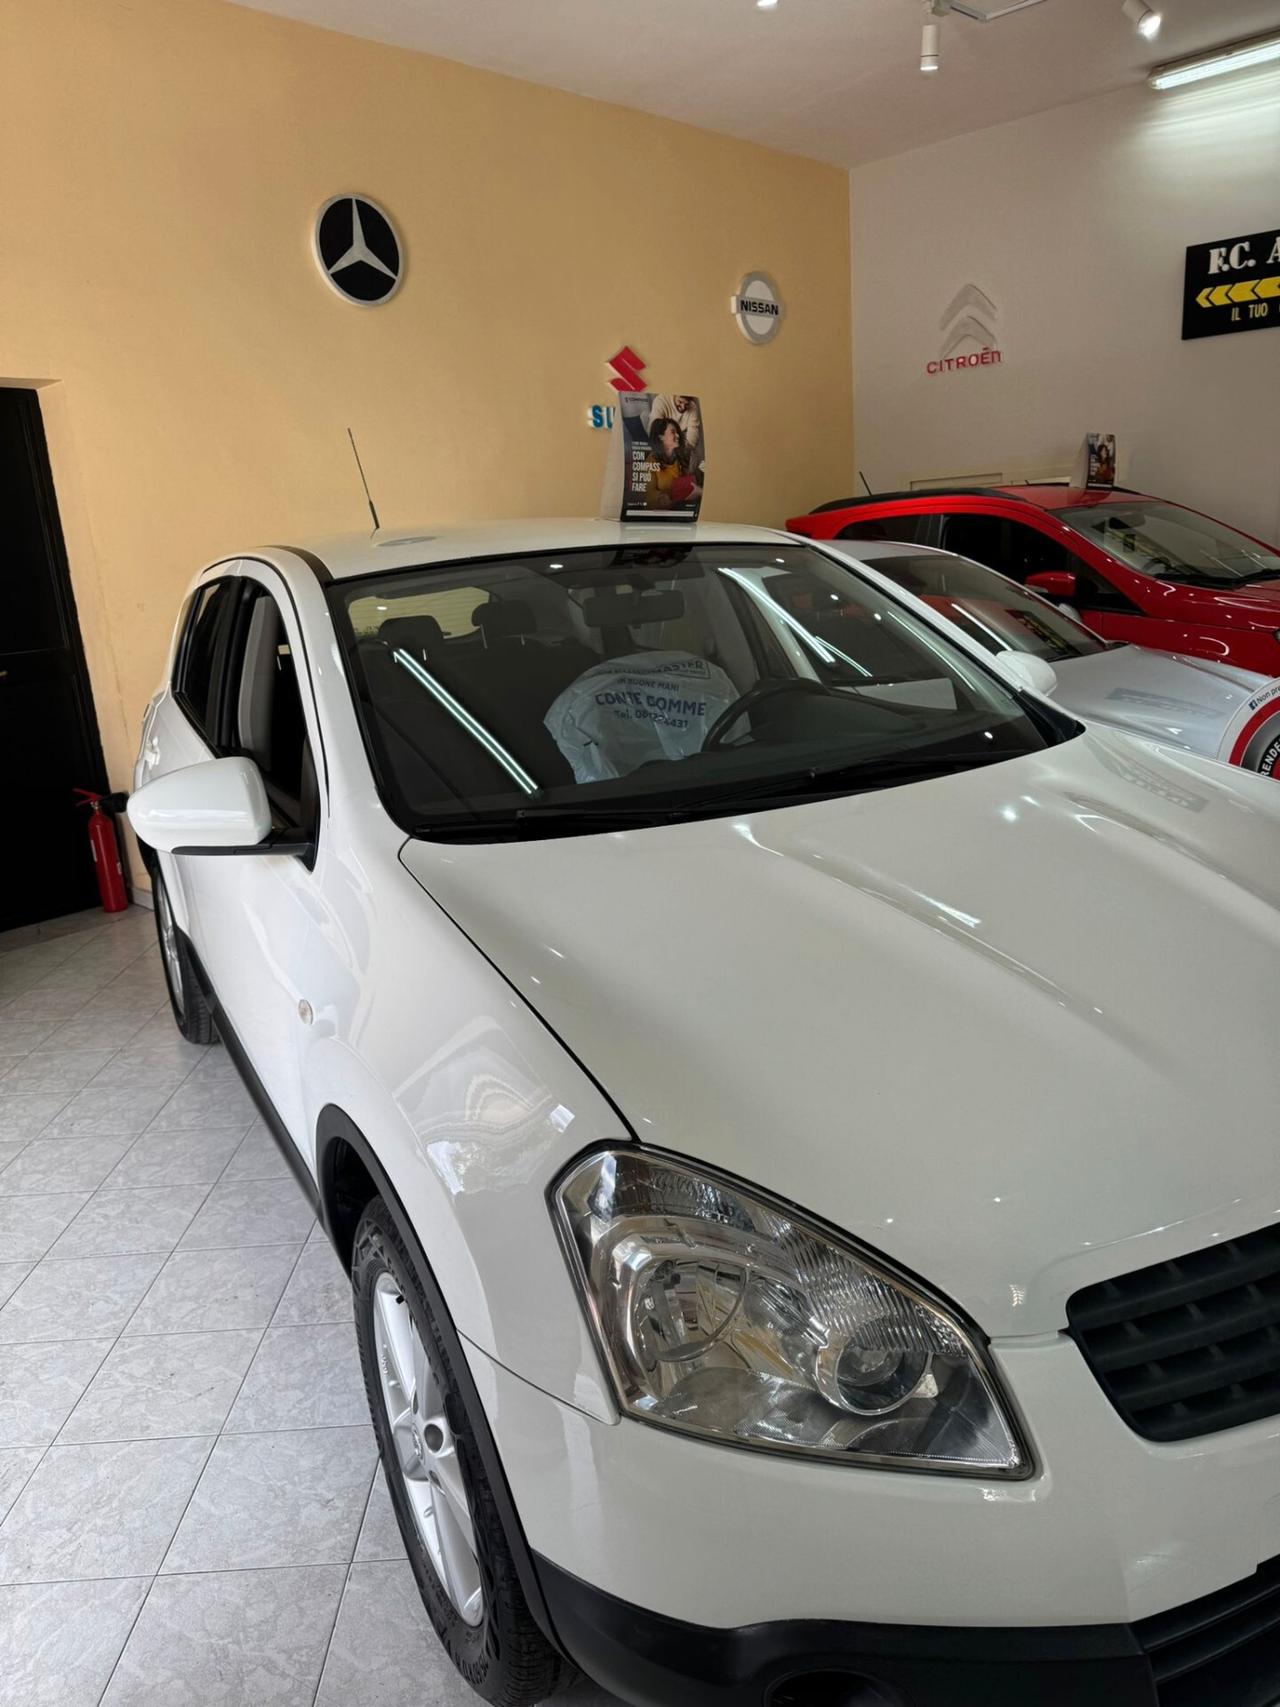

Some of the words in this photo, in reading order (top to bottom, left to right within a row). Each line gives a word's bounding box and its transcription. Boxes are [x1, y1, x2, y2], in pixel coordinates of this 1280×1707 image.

[1208, 241, 1256, 274] F.C.
[741, 300, 779, 315] NISSAN
[1231, 307, 1241, 321] IL
[1248, 302, 1268, 318] TUO
[632, 451, 645, 460] CON
[632, 461, 660, 472] COMPASS
[632, 483, 647, 492] FARE
[595, 691, 642, 706] CONTE
[646, 695, 707, 716] GOMME
[1256, 691, 1271, 704] Non
